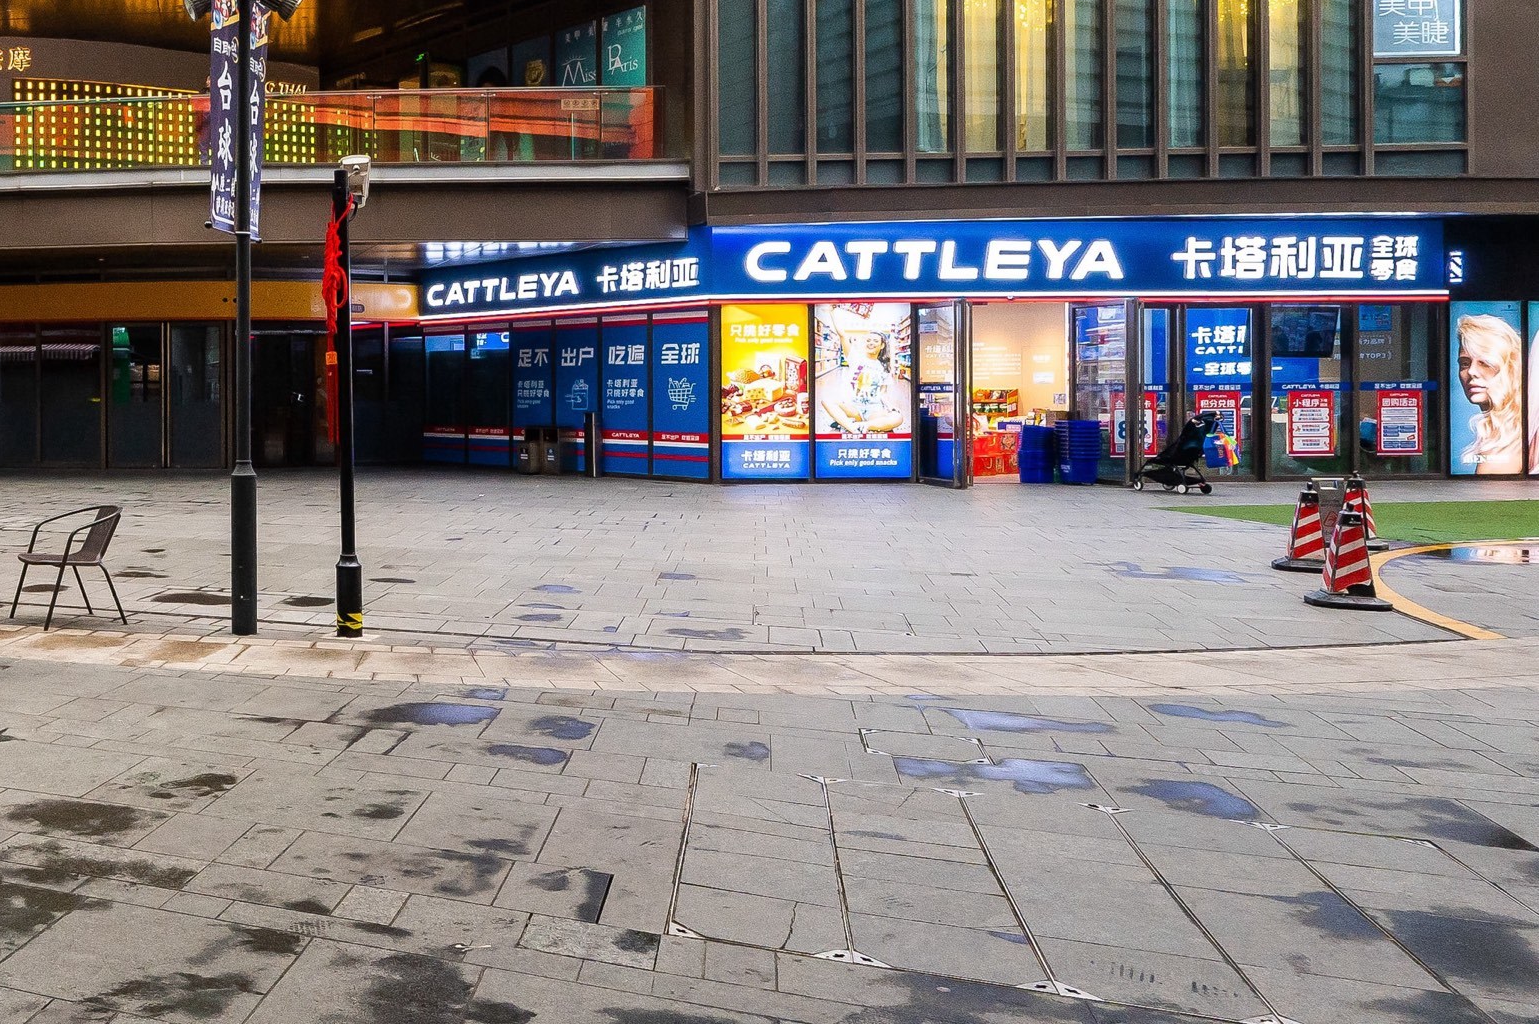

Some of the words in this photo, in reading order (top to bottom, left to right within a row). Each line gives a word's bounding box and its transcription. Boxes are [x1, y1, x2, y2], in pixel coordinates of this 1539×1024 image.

[1392, 20, 1450, 45] 美睫
[1371, 234, 1419, 258] 全球
[745, 239, 1125, 282] CATTLEYA
[1171, 235, 1365, 281] 卡塔利亚
[596, 257, 700, 295] 卡塔利亚
[1370, 259, 1418, 281] 零食
[426, 270, 580, 308] CATTLEYA
[730, 323, 800, 337] 只挑好零食
[517, 348, 550, 368] 足不
[561, 346, 595, 367] 出户
[608, 344, 646, 365] 吃遍
[661, 342, 701, 365] 全球
[606, 378, 638, 388] 卡塔利亚
[1200, 399, 1236, 408] 积分兑换
[1292, 398, 1320, 408] 小程序
[1381, 398, 1418, 407] 团购活动
[741, 449, 791, 462] 卡塔利亚
[838, 448, 892, 459] 只挑好零食
